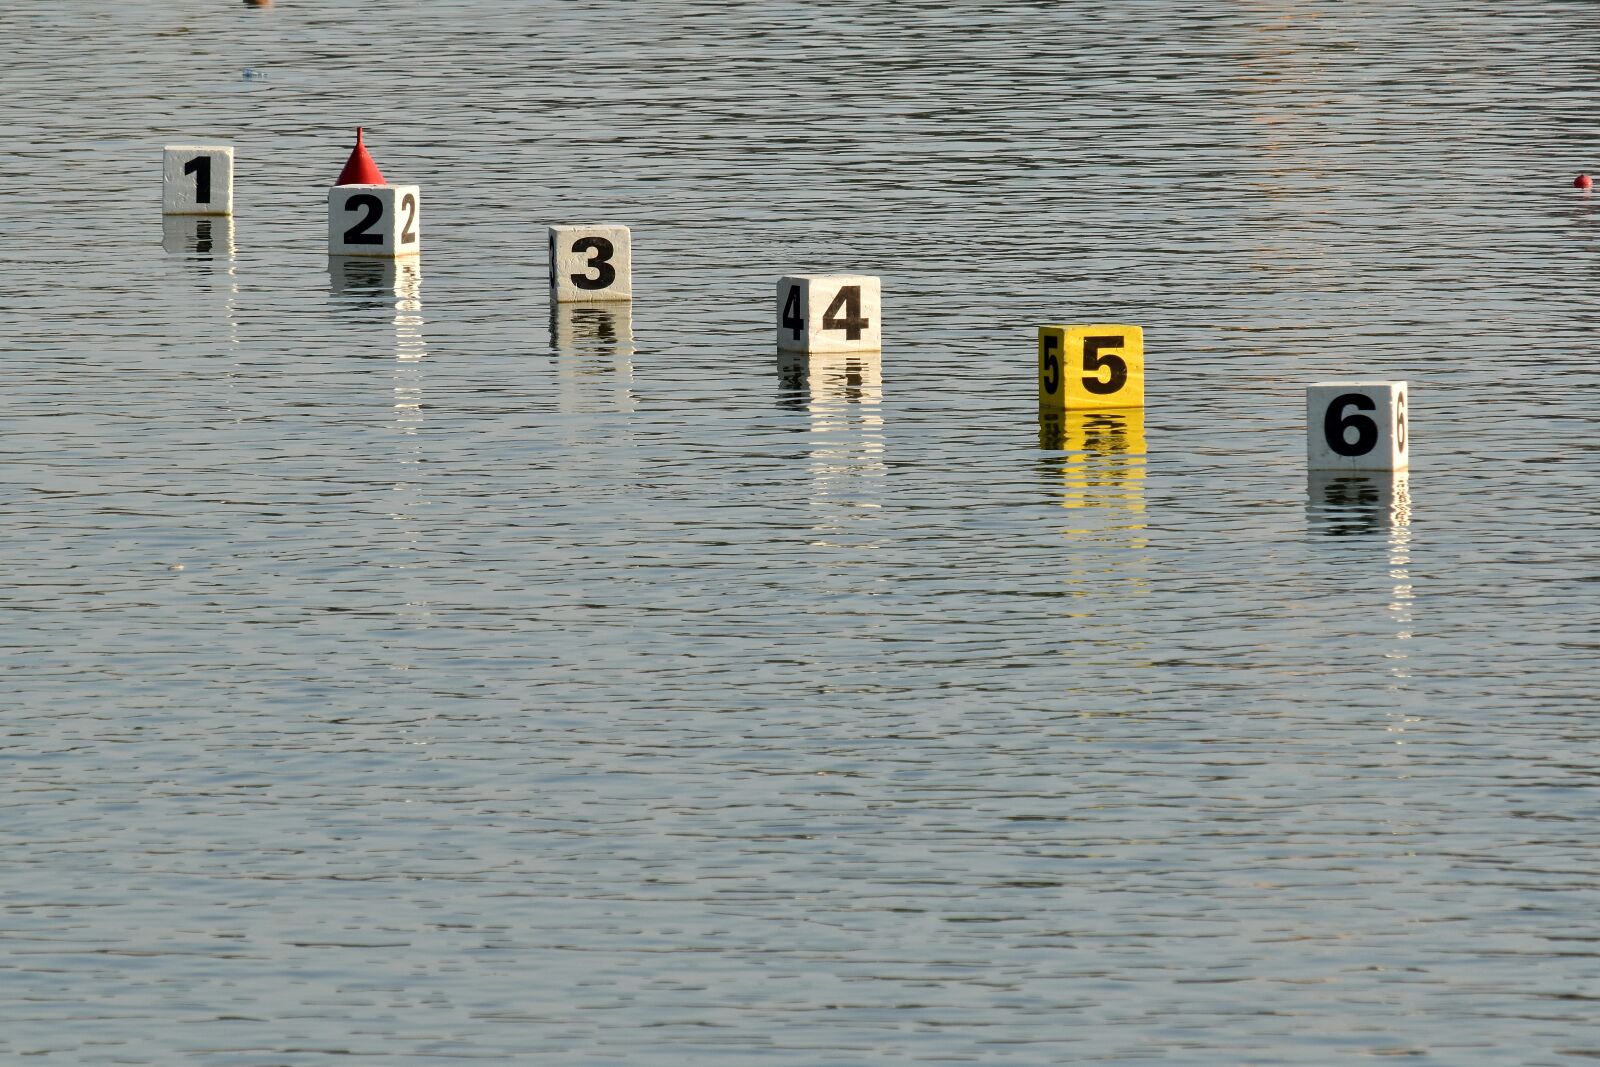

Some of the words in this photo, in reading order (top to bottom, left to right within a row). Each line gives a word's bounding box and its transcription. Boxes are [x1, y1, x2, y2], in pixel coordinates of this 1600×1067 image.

[184, 156, 211, 203] 1
[344, 194, 384, 245] 2
[401, 194, 416, 244] 2
[571, 237, 616, 290] 3
[783, 285, 805, 340] 4
[822, 286, 869, 340] 4
[1044, 336, 1060, 394] 5
[1082, 336, 1127, 395] 5
[1324, 394, 1378, 456] 6
[1397, 391, 1406, 453] 6
